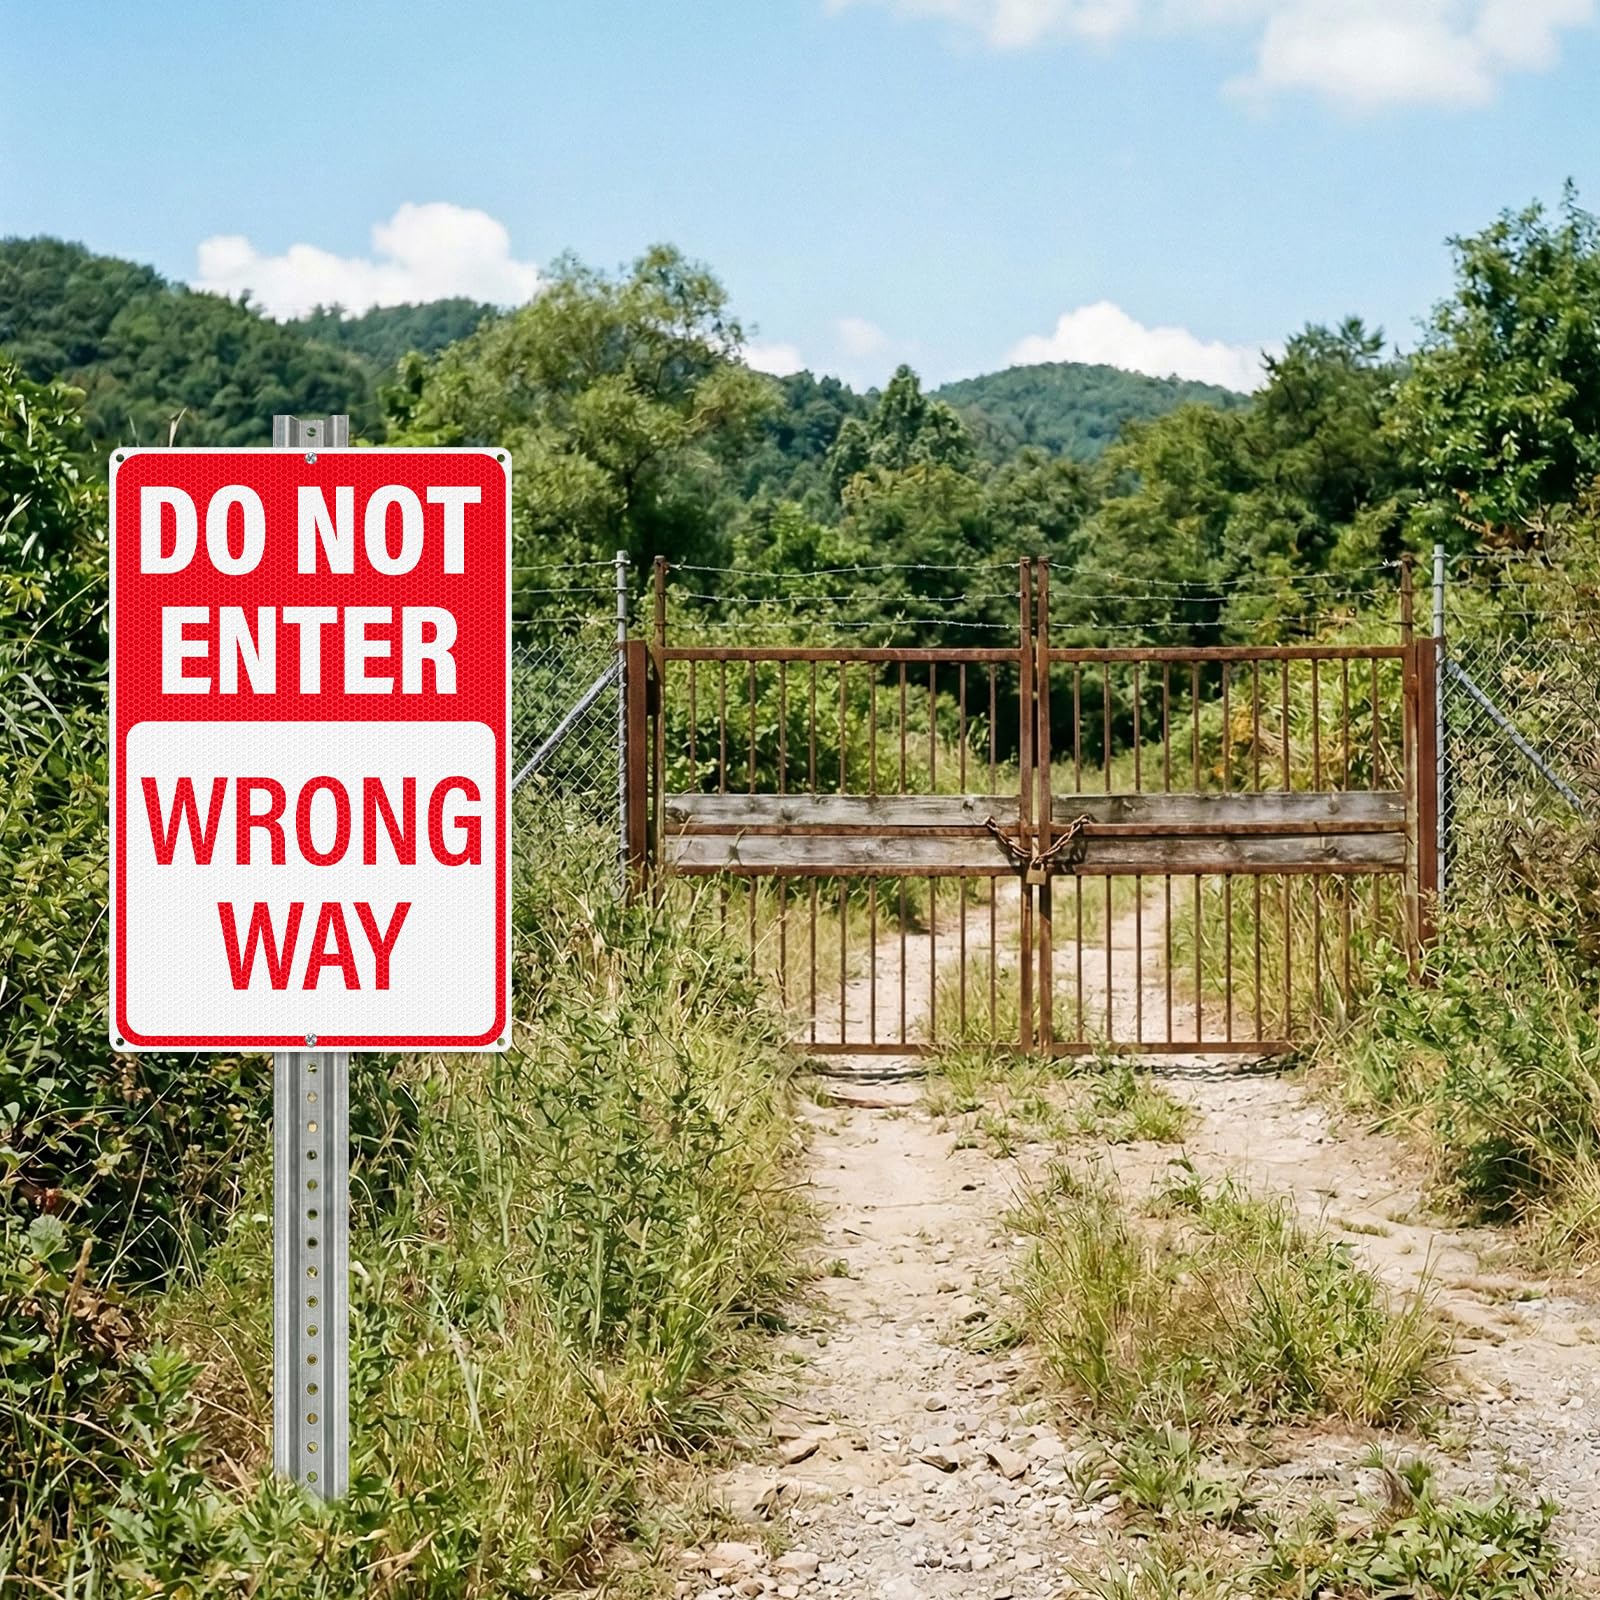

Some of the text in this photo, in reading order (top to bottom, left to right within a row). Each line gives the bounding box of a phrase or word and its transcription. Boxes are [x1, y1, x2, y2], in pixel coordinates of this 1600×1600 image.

[140, 485, 481, 575] DO NOT
[161, 606, 458, 694] ENTER
[140, 776, 482, 866] WRONG
[217, 902, 412, 990] WAY
